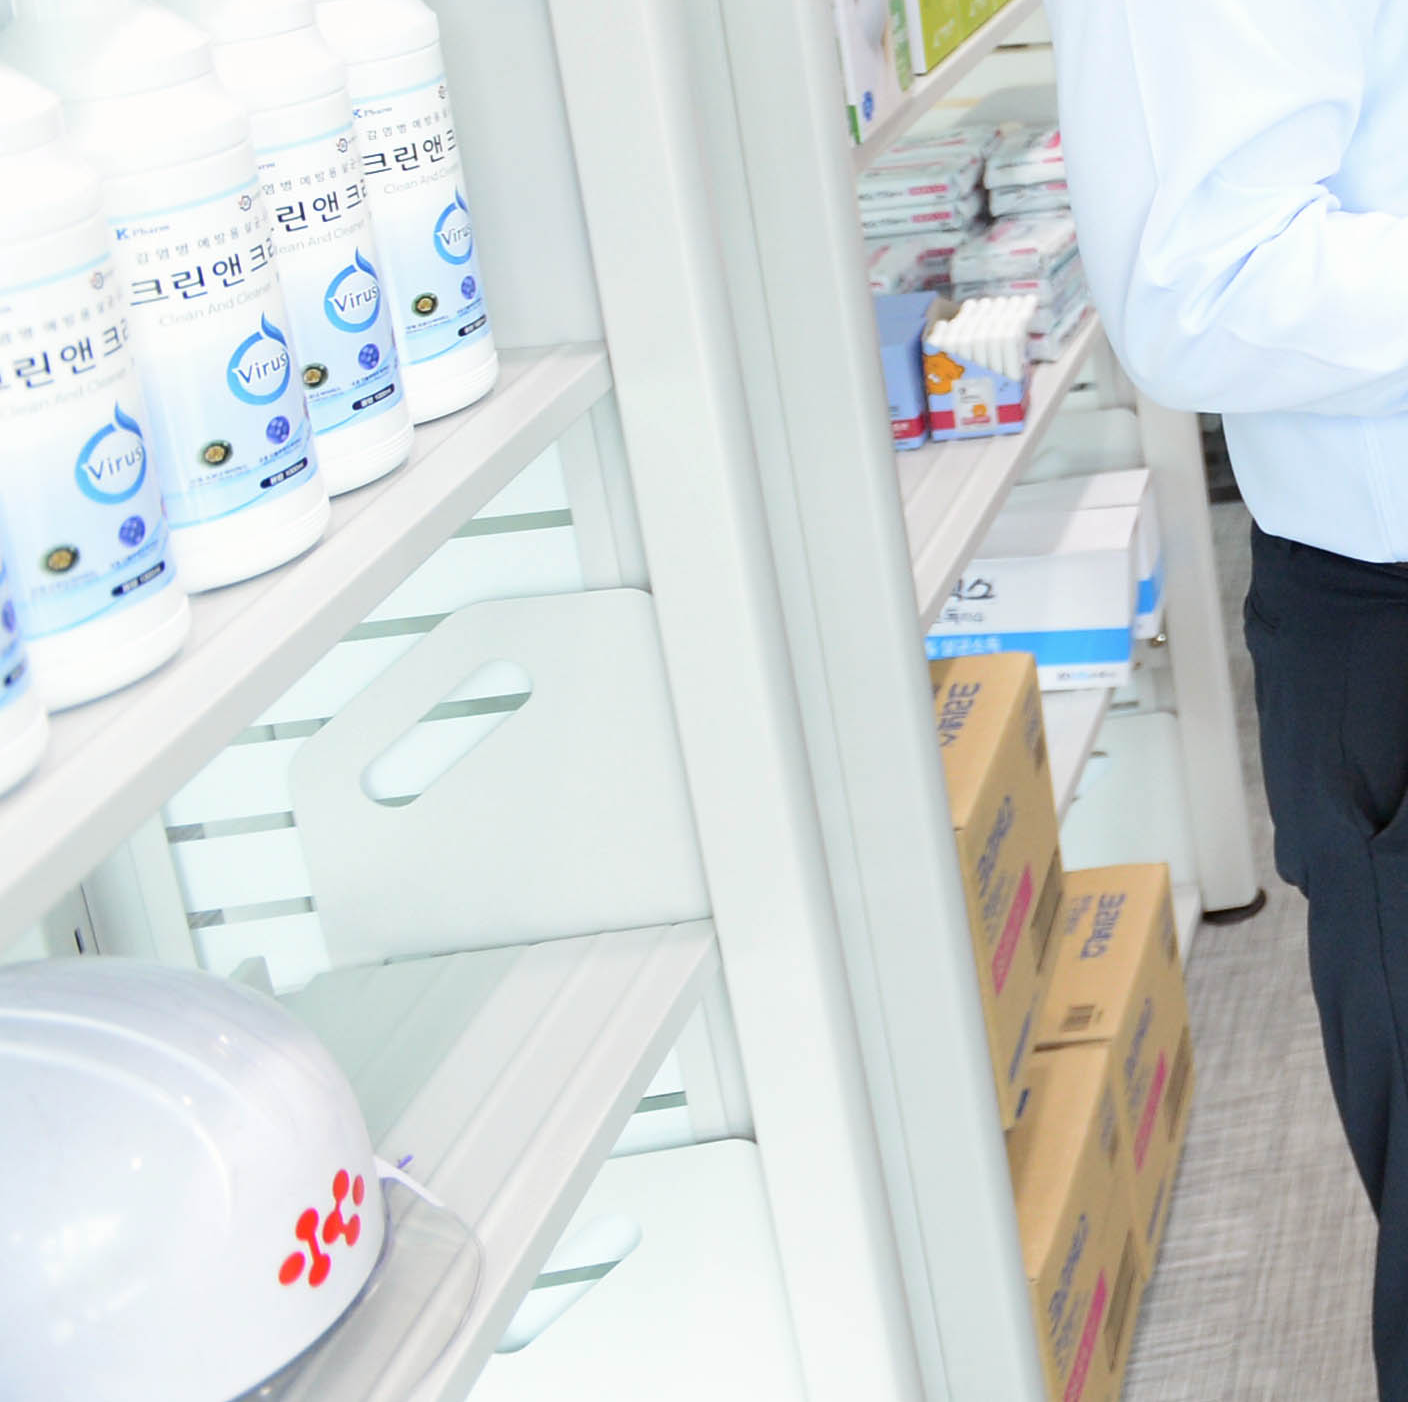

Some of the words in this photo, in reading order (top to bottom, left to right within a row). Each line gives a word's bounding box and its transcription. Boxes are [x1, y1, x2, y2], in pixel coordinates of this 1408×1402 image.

[333, 284, 379, 313] Virus
[237, 351, 288, 384] Virus
[87, 446, 144, 481] Virus
